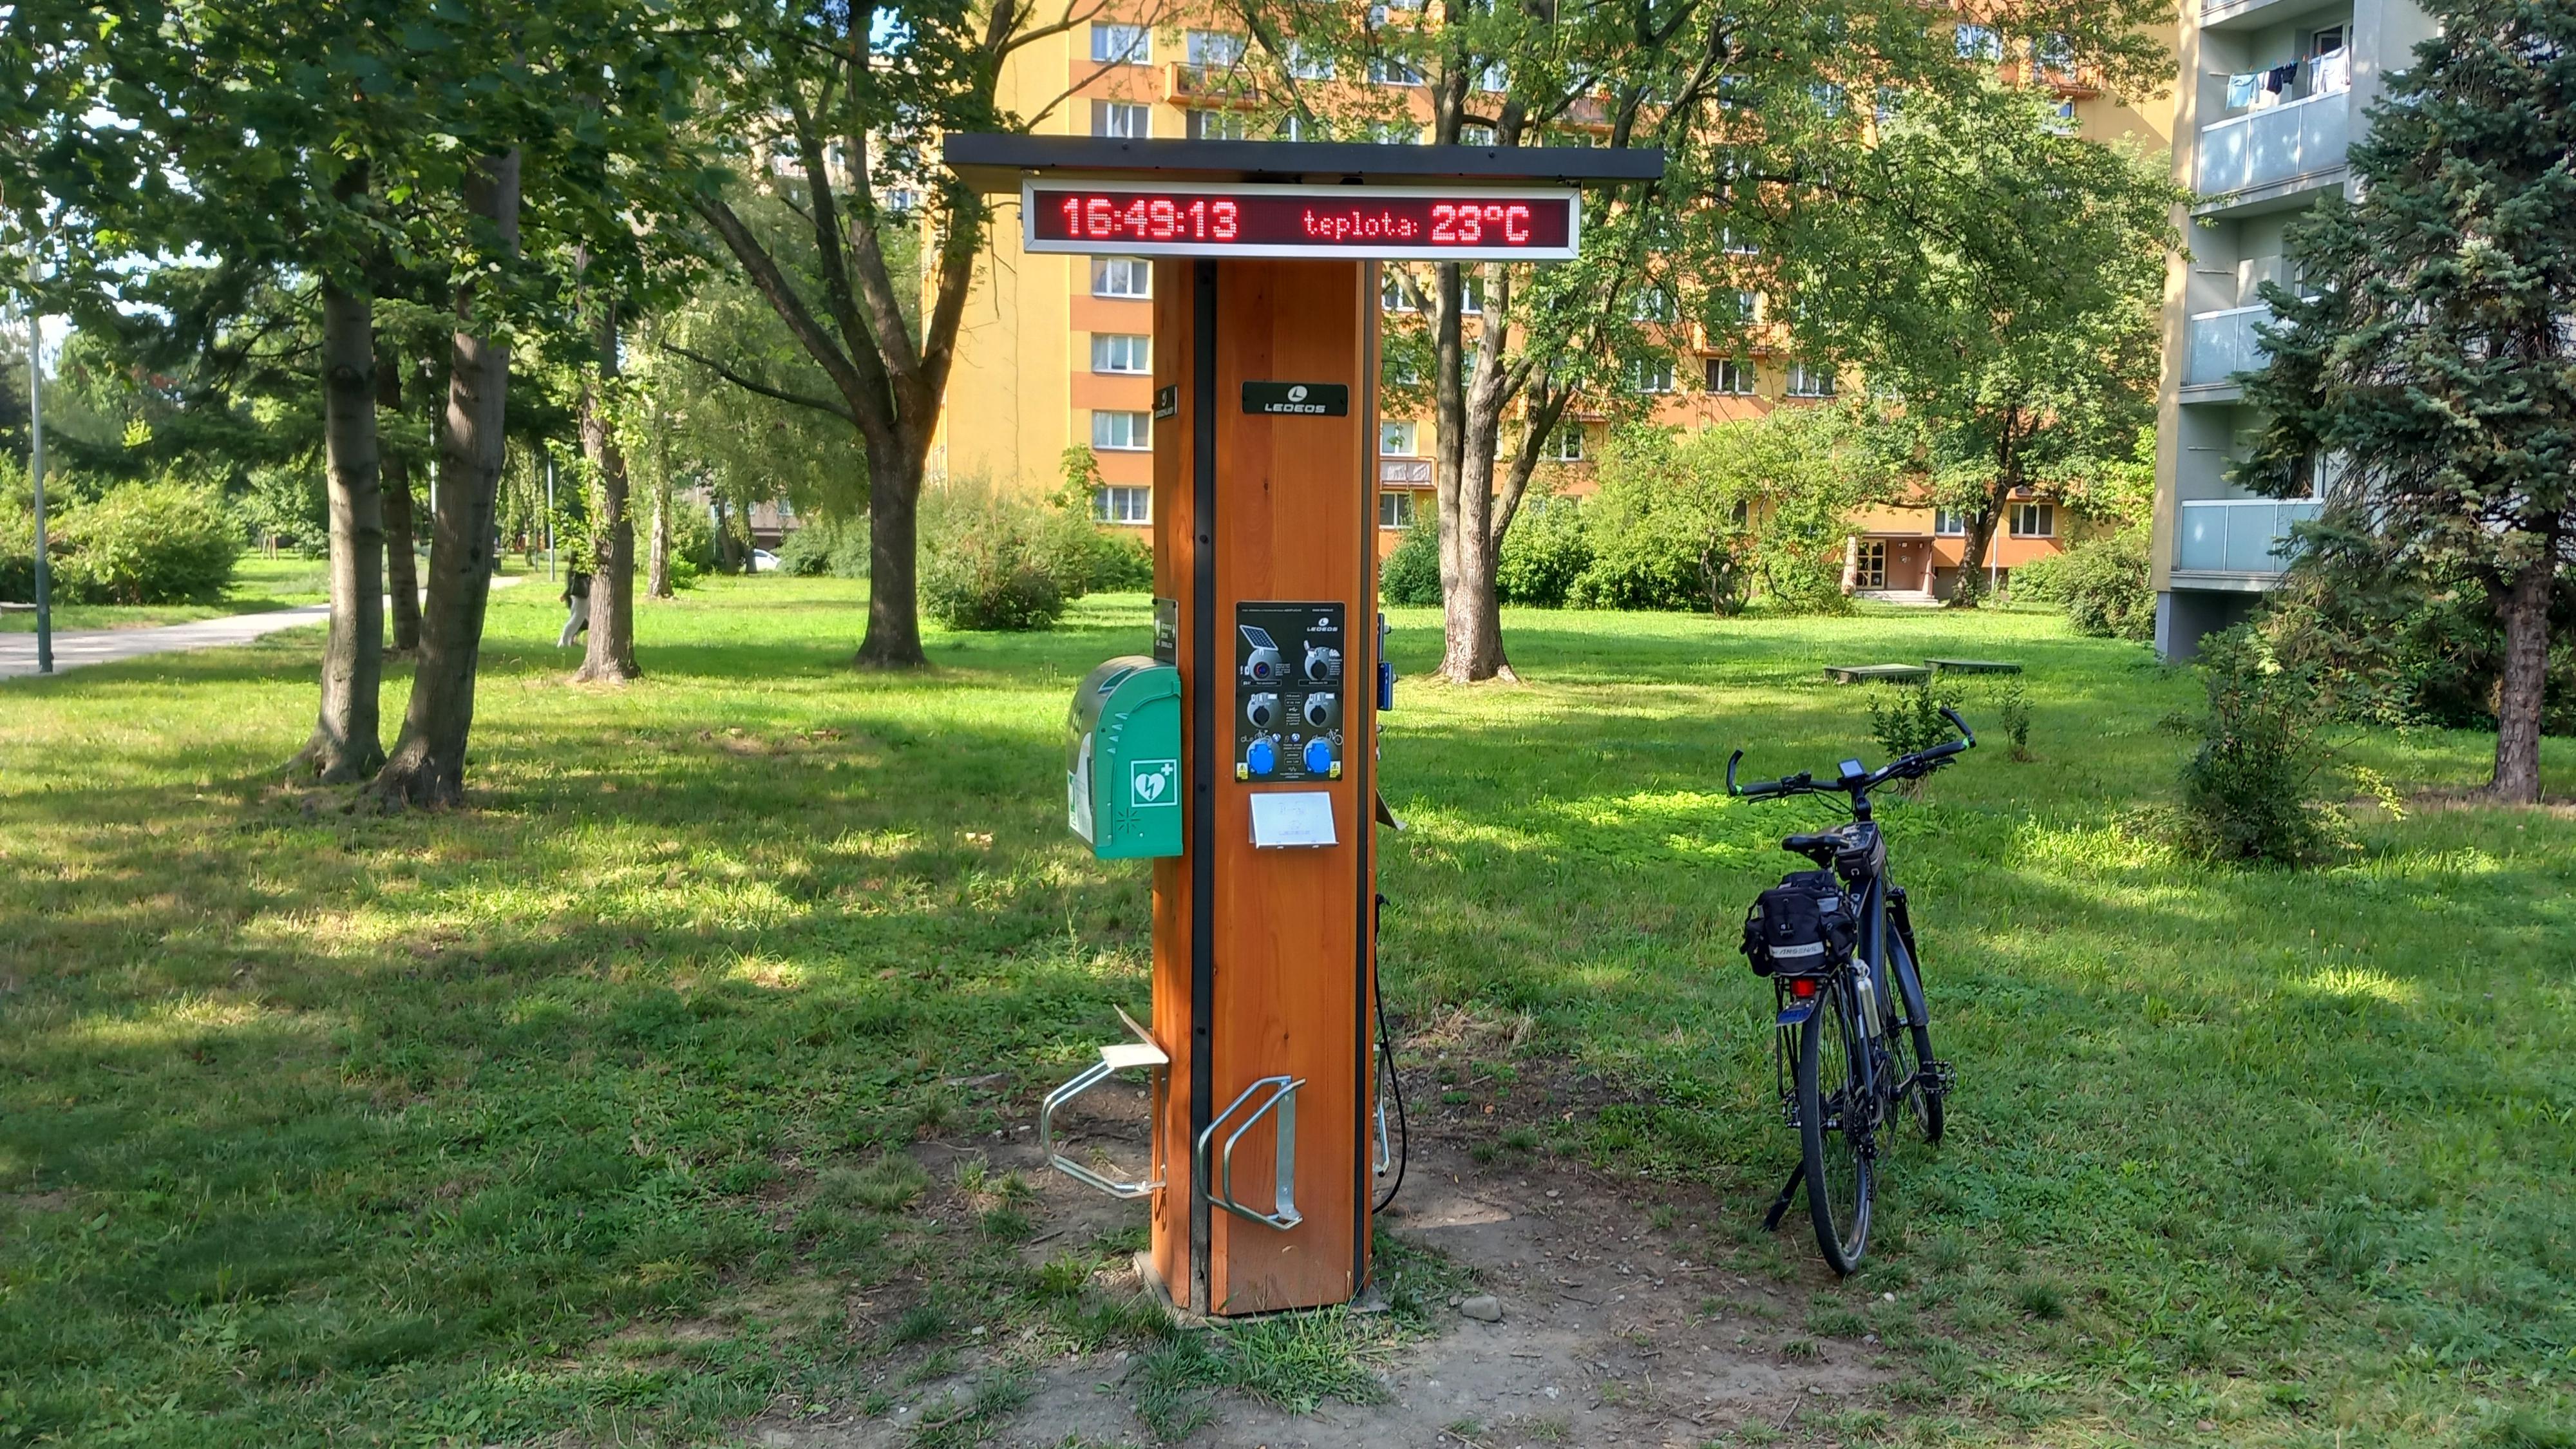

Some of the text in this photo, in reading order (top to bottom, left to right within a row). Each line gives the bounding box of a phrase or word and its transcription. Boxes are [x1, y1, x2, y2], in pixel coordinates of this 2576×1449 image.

[1063, 198, 1529, 242] 16:49:13 teplota: 23°C
[1264, 402, 1326, 413] LEDEOS
[1779, 946, 1817, 955] ARSENAL
